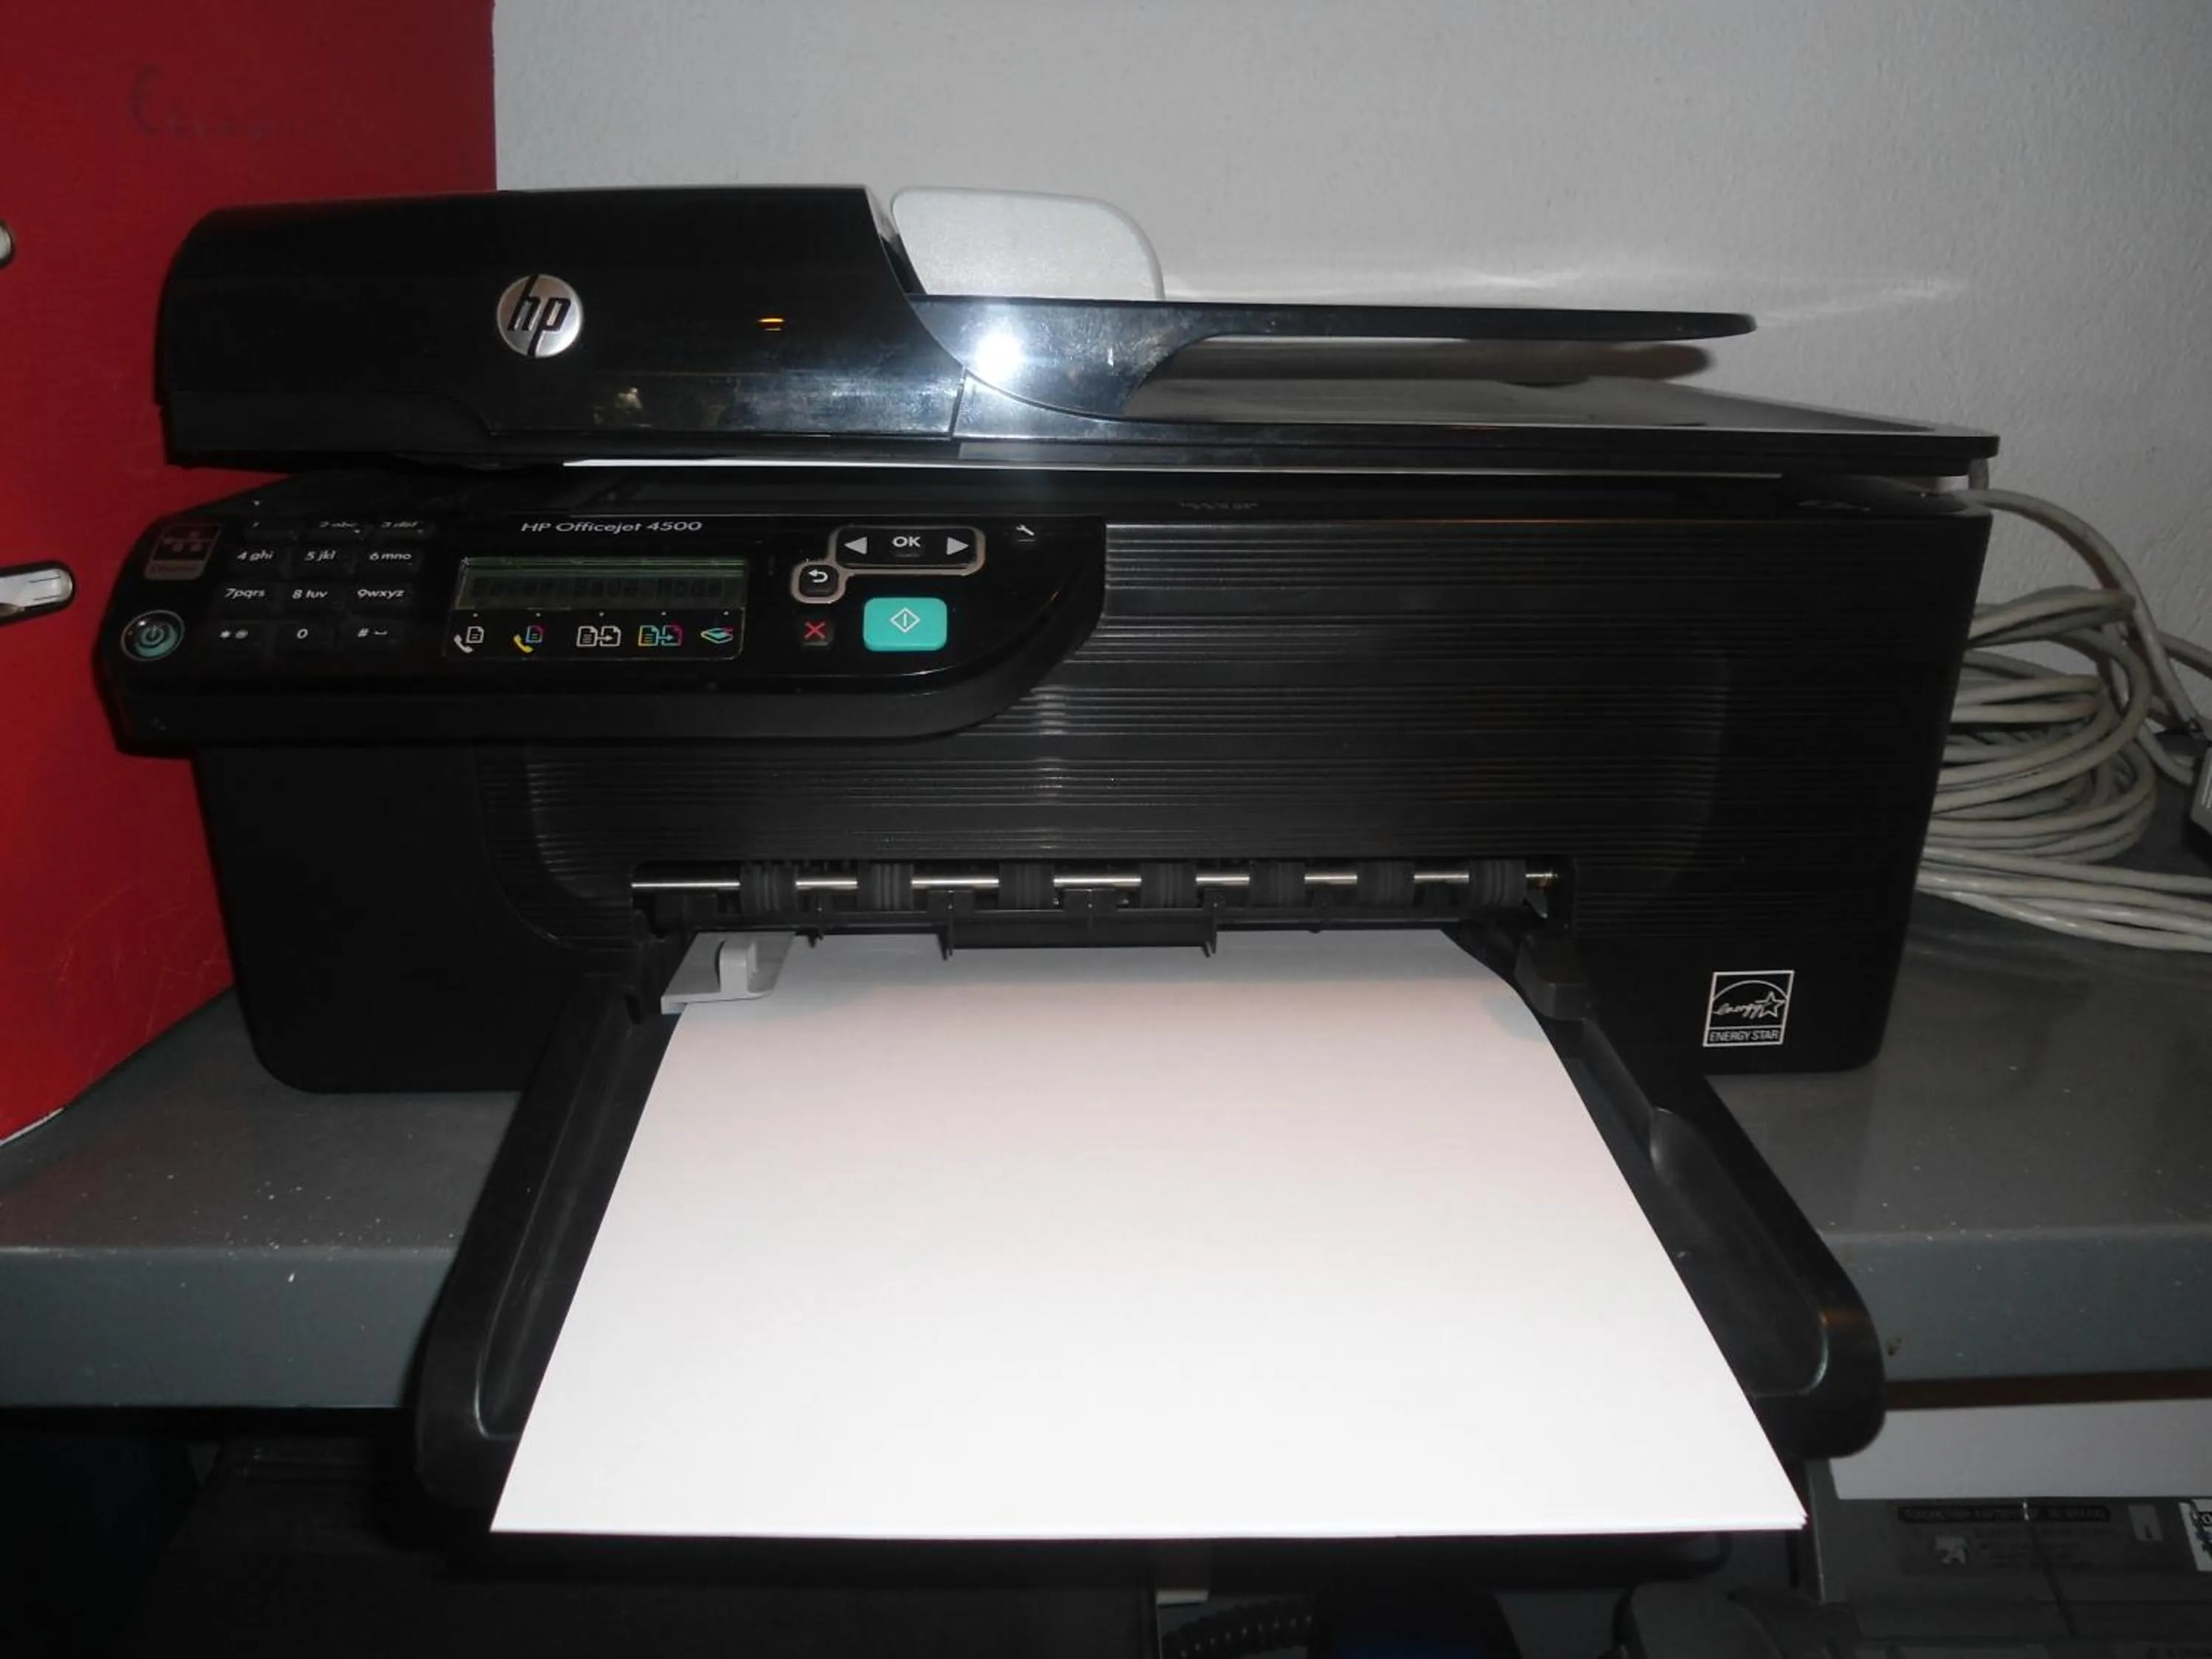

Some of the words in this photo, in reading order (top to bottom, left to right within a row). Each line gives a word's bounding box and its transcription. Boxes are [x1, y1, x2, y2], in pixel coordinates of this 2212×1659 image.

[507, 274, 571, 357] hp
[521, 522, 552, 532] HP
[554, 521, 642, 535] Officejet
[646, 521, 703, 532] 4500
[891, 535, 921, 548] OK
[237, 552, 248, 560] 4
[249, 549, 275, 561] ghi
[304, 551, 316, 560] 5
[317, 550, 337, 561] jkl
[369, 552, 380, 560] 6
[381, 552, 411, 560] mno
[292, 589, 303, 599] 8
[305, 589, 328, 598] tuv
[296, 628, 308, 639] 0
[1709, 1030, 1748, 1043] ENERGY
[1750, 1029, 1780, 1041] STAR
